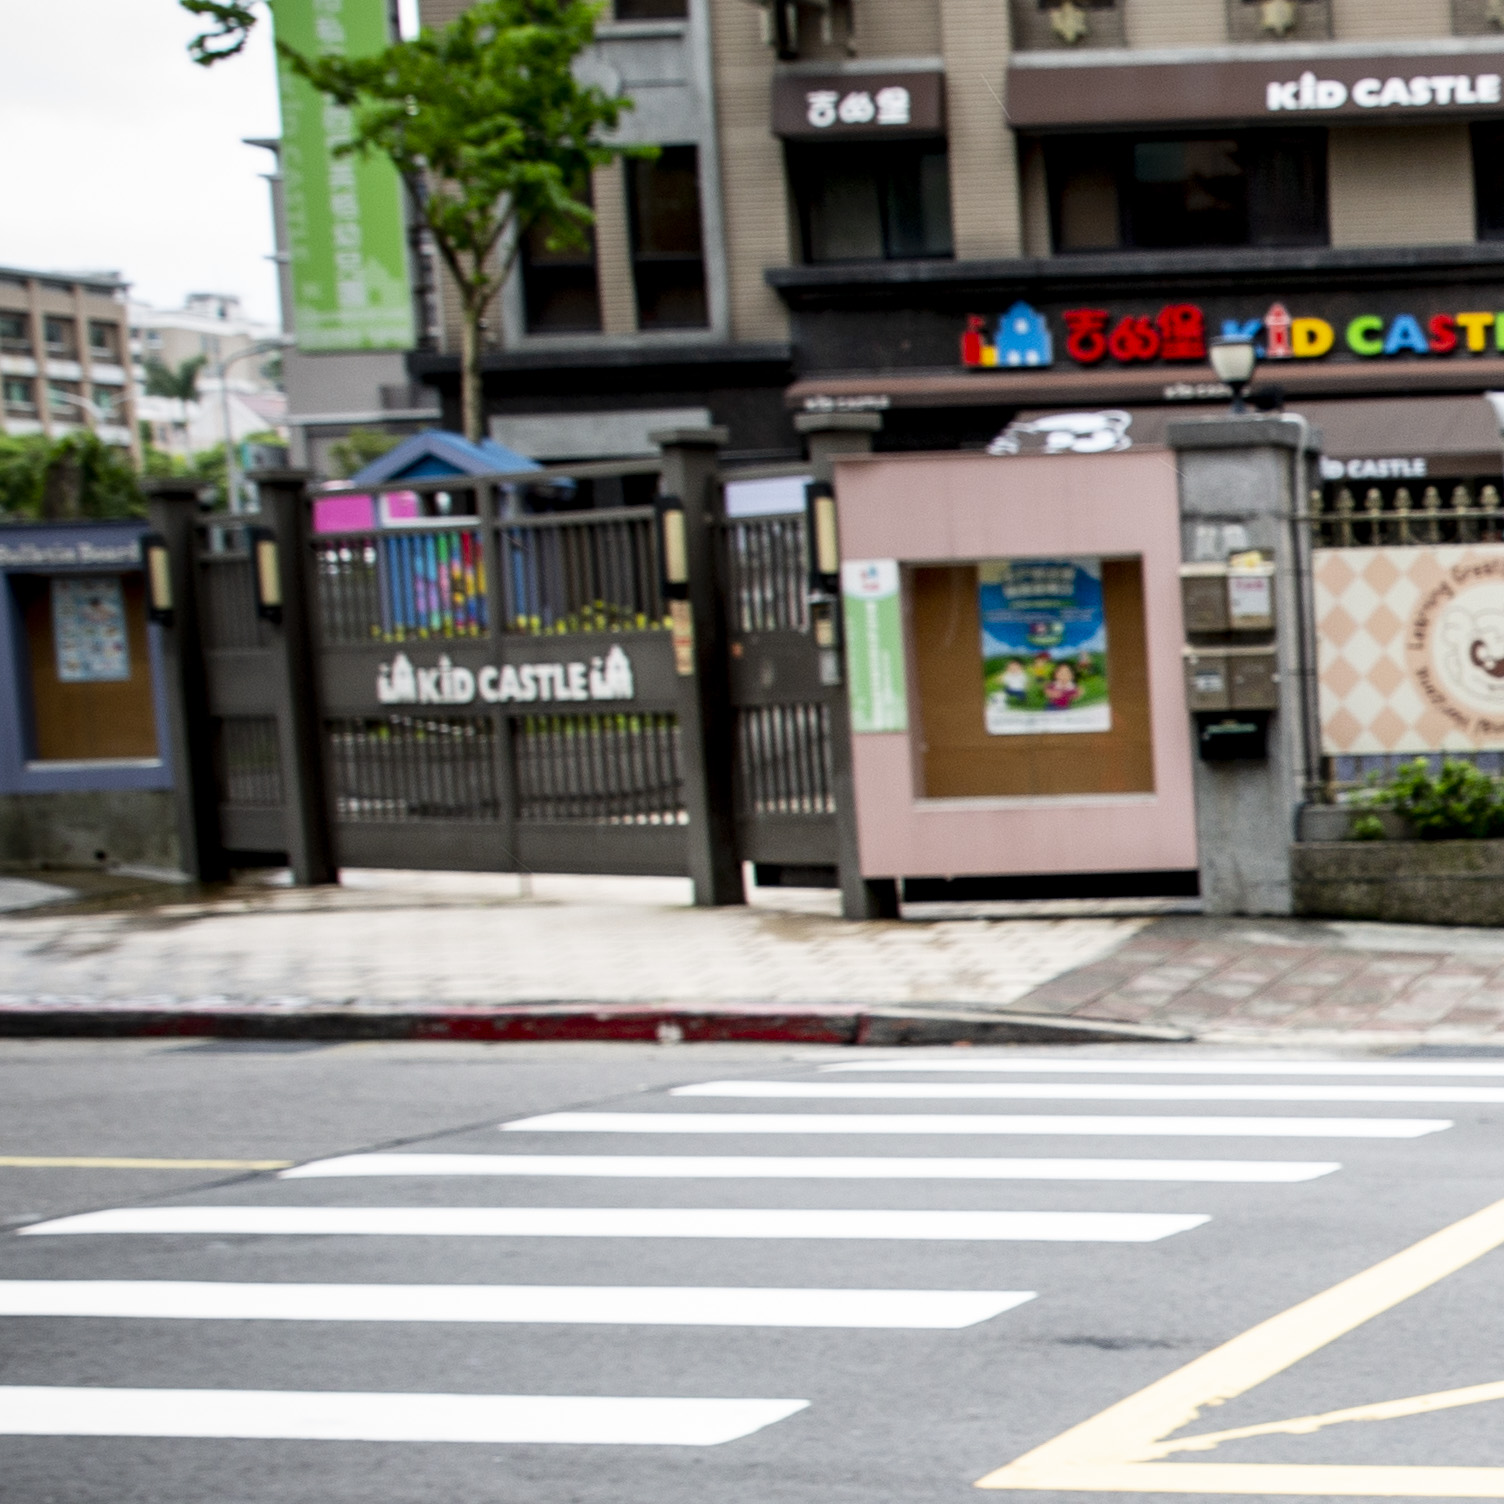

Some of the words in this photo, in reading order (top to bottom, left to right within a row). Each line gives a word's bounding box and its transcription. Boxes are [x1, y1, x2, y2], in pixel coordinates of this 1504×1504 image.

[1352, 74, 1501, 107] CASTLE
[1347, 457, 1428, 479] CASTLE
[478, 661, 588, 702] CASTLE
